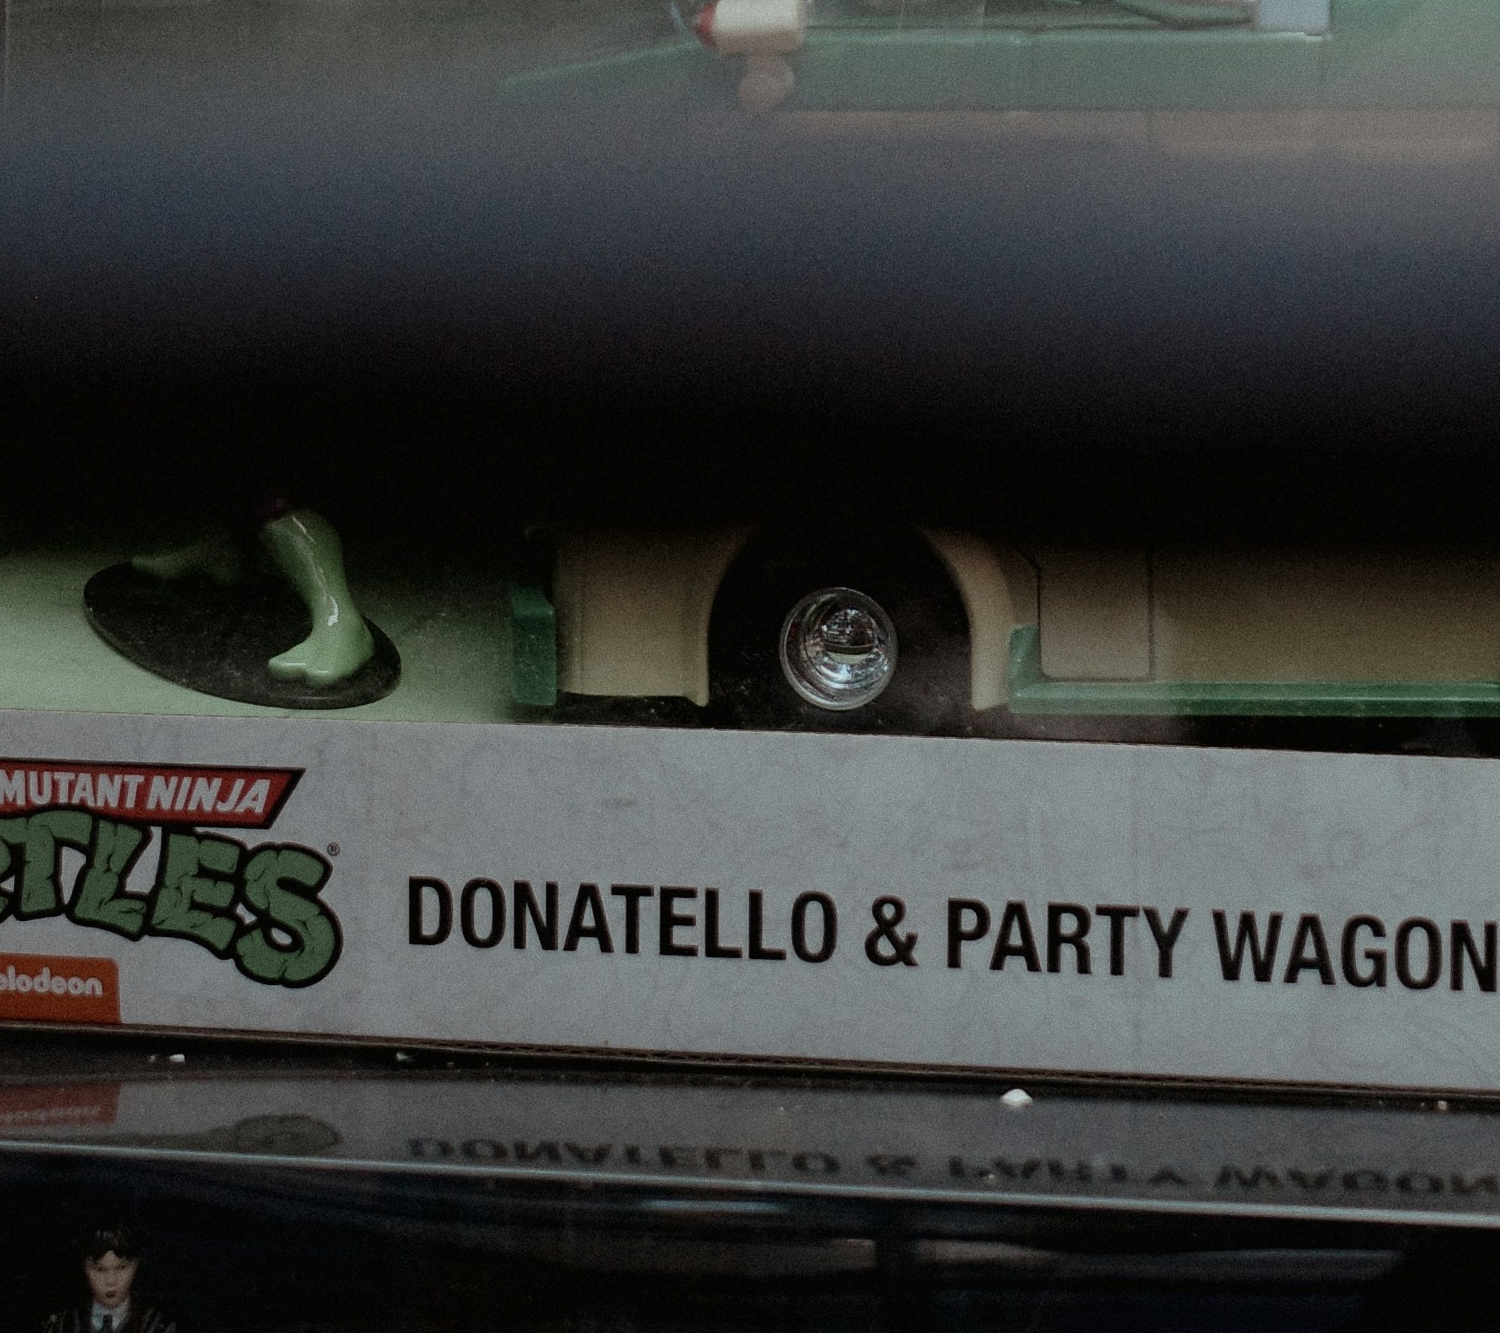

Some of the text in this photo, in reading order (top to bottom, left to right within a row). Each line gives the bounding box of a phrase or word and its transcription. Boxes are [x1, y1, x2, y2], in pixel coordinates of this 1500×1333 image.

[147, 772, 272, 815] NINJA
[407, 874, 1499, 994] DONATELLO & PARTY WAGON
